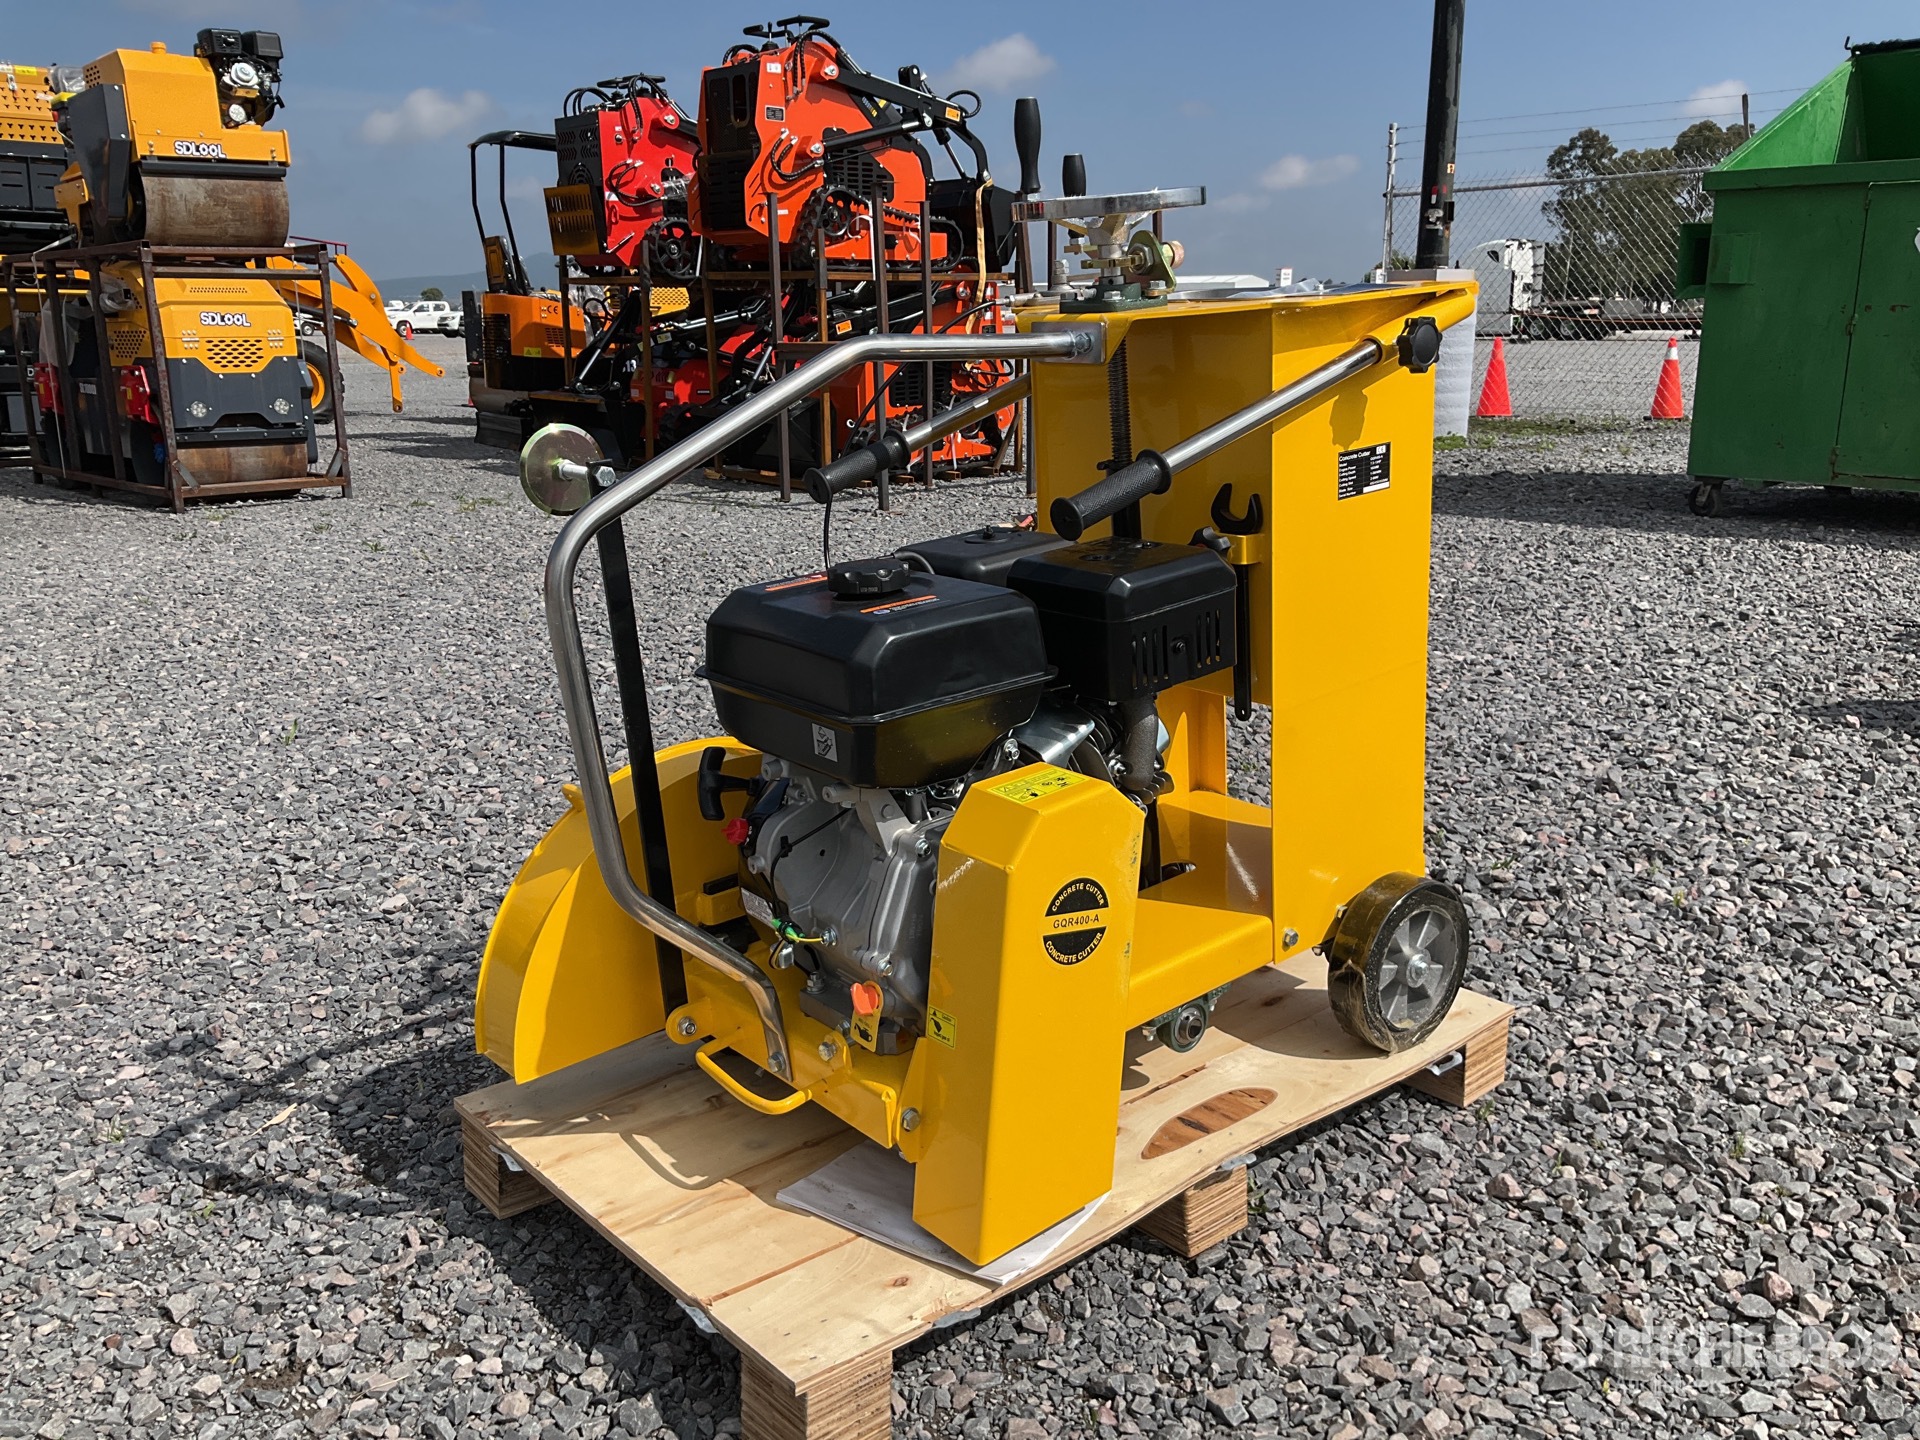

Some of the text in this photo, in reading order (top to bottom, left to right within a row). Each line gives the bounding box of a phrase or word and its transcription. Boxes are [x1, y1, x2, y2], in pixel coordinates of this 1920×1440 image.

[1052, 883, 1104, 912] CONCRETE CUTTER
[1053, 914, 1099, 928] GQR400-A
[1046, 932, 1102, 963] CONCRETE CUTTER
